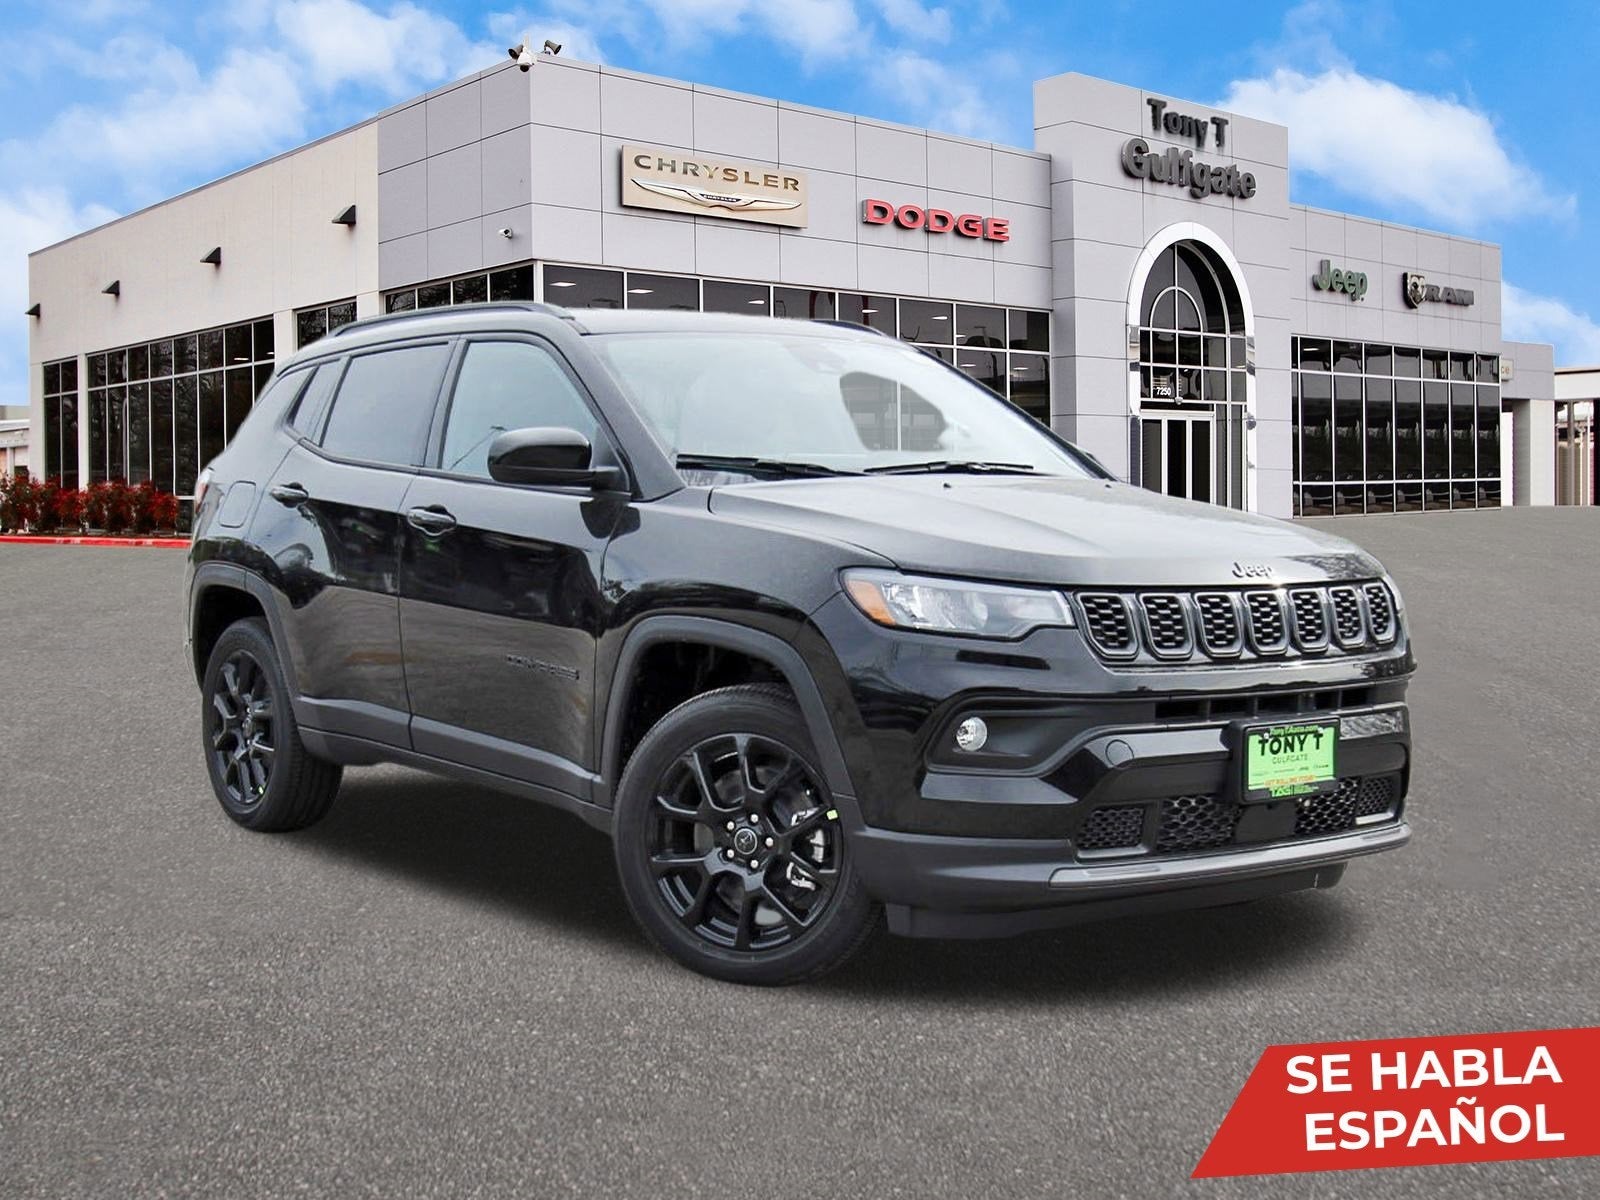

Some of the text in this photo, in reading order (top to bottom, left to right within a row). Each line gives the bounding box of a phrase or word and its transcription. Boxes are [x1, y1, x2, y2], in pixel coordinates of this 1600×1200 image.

[1147, 98, 1229, 147] Tony T
[633, 154, 801, 192] CHRYSLER
[1121, 138, 1256, 199] Gulfgate
[862, 199, 1011, 242] DODGE
[1313, 259, 1368, 301] Jeep
[1424, 284, 1474, 306] RAM
[1156, 387, 1171, 396] 7250
[1232, 562, 1272, 579] Jeep
[1258, 732, 1324, 756] TONY T
